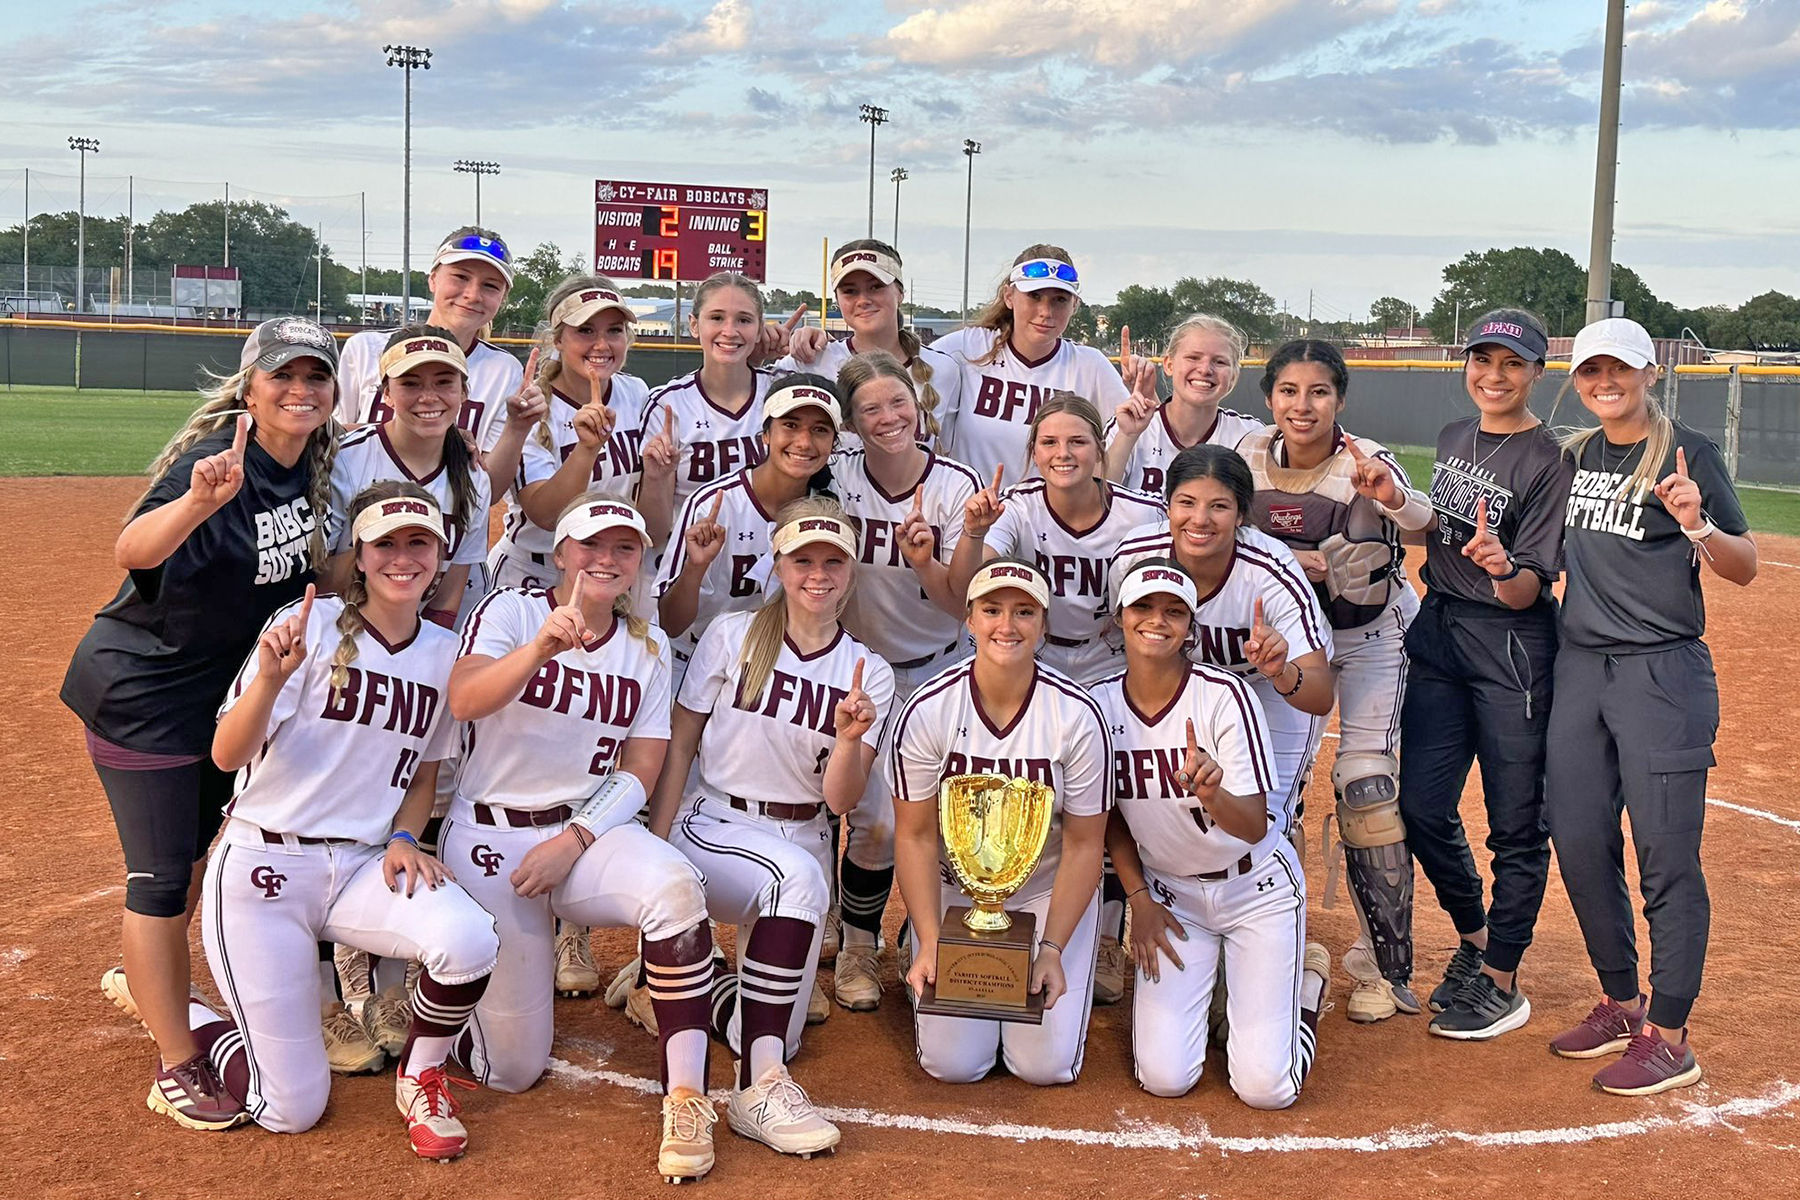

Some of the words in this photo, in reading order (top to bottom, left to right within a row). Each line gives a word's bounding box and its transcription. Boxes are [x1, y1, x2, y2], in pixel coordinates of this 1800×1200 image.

[619, 186, 678, 201] CY-FAIR
[686, 190, 745, 205] BOBCATS
[598, 211, 642, 227] VISITOR
[660, 206, 679, 237] 2
[689, 215, 740, 232] INNING
[746, 210, 764, 241] 3
[608, 239, 617, 250] H
[629, 240, 636, 251] E
[708, 243, 731, 255] BALL
[841, 252, 877, 267] BFND
[597, 255, 641, 271] BOBCATS
[653, 249, 678, 280] 19
[709, 256, 744, 268] STRIKE
[1480, 321, 1523, 338] BFND
[973, 374, 1075, 425] BFN
[687, 436, 766, 483] BFN
[1446, 456, 1497, 482] SOFTBALL
[1564, 495, 1646, 541] OFTBALL
[254, 537, 313, 585] SOFT
[990, 567, 1033, 583] BFND
[1034, 549, 1111, 598] BFN
[320, 665, 439, 739] BFND
[519, 658, 642, 728] BFND
[588, 737, 620, 776] 2
[470, 844, 504, 877] CF
[250, 866, 287, 898] CF
[954, 971, 979, 979] VARSITY
[980, 973, 1011, 982] SOFTBALL
[978, 980, 1015, 989] CHAMPIONS
